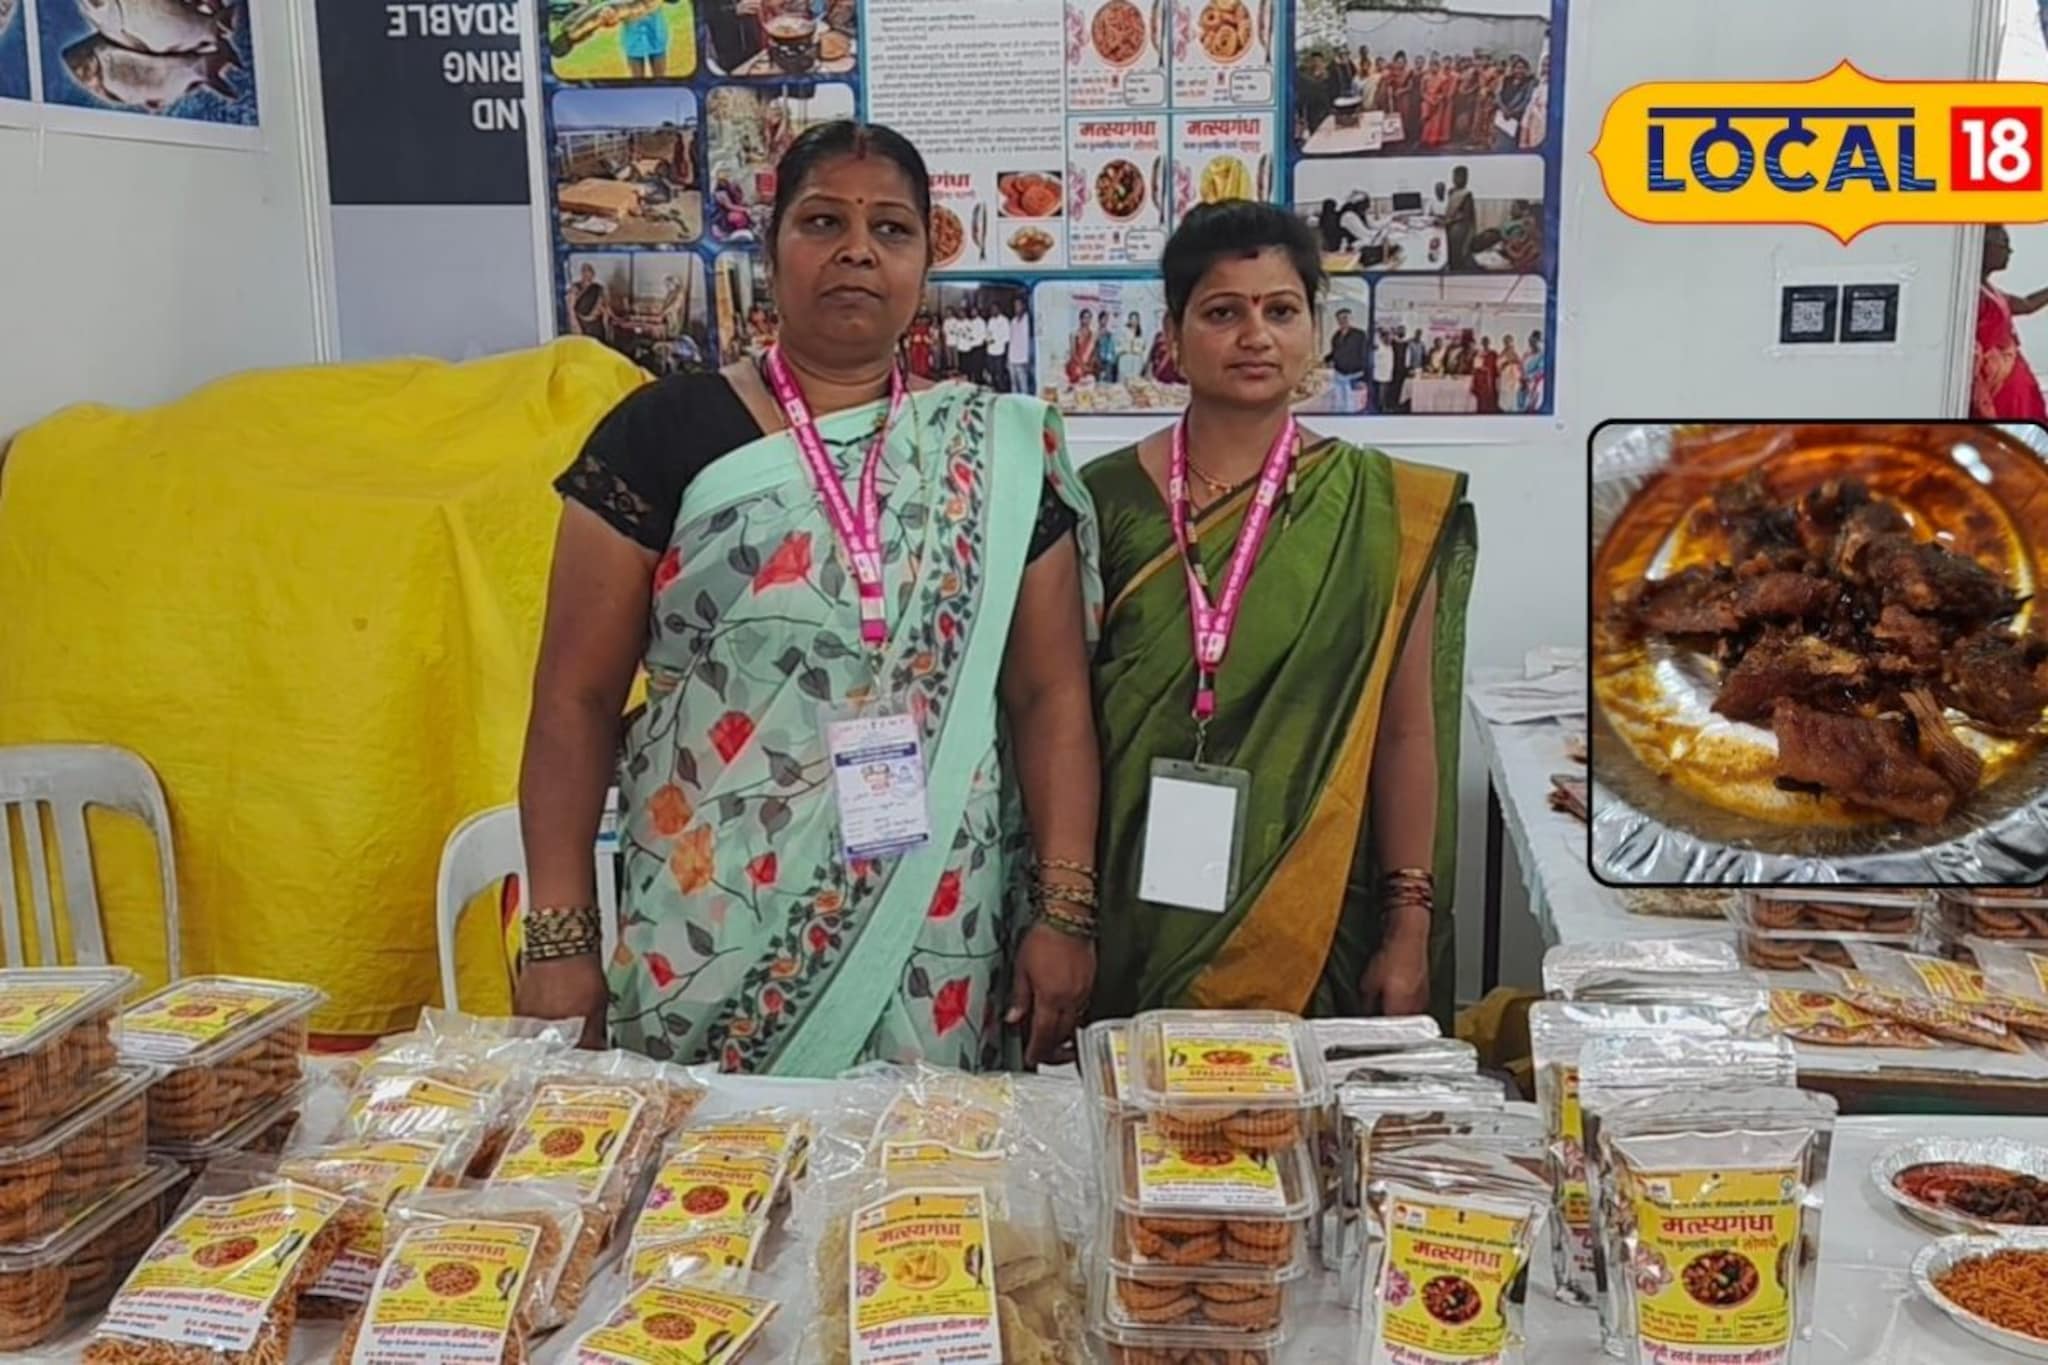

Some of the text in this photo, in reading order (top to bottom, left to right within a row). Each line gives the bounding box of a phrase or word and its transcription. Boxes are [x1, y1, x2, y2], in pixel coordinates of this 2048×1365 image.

[386, 3, 519, 36] RDABLE
[443, 51, 522, 83] RING
[1661, 1211, 1776, 1234] मत्स्यगंधा
